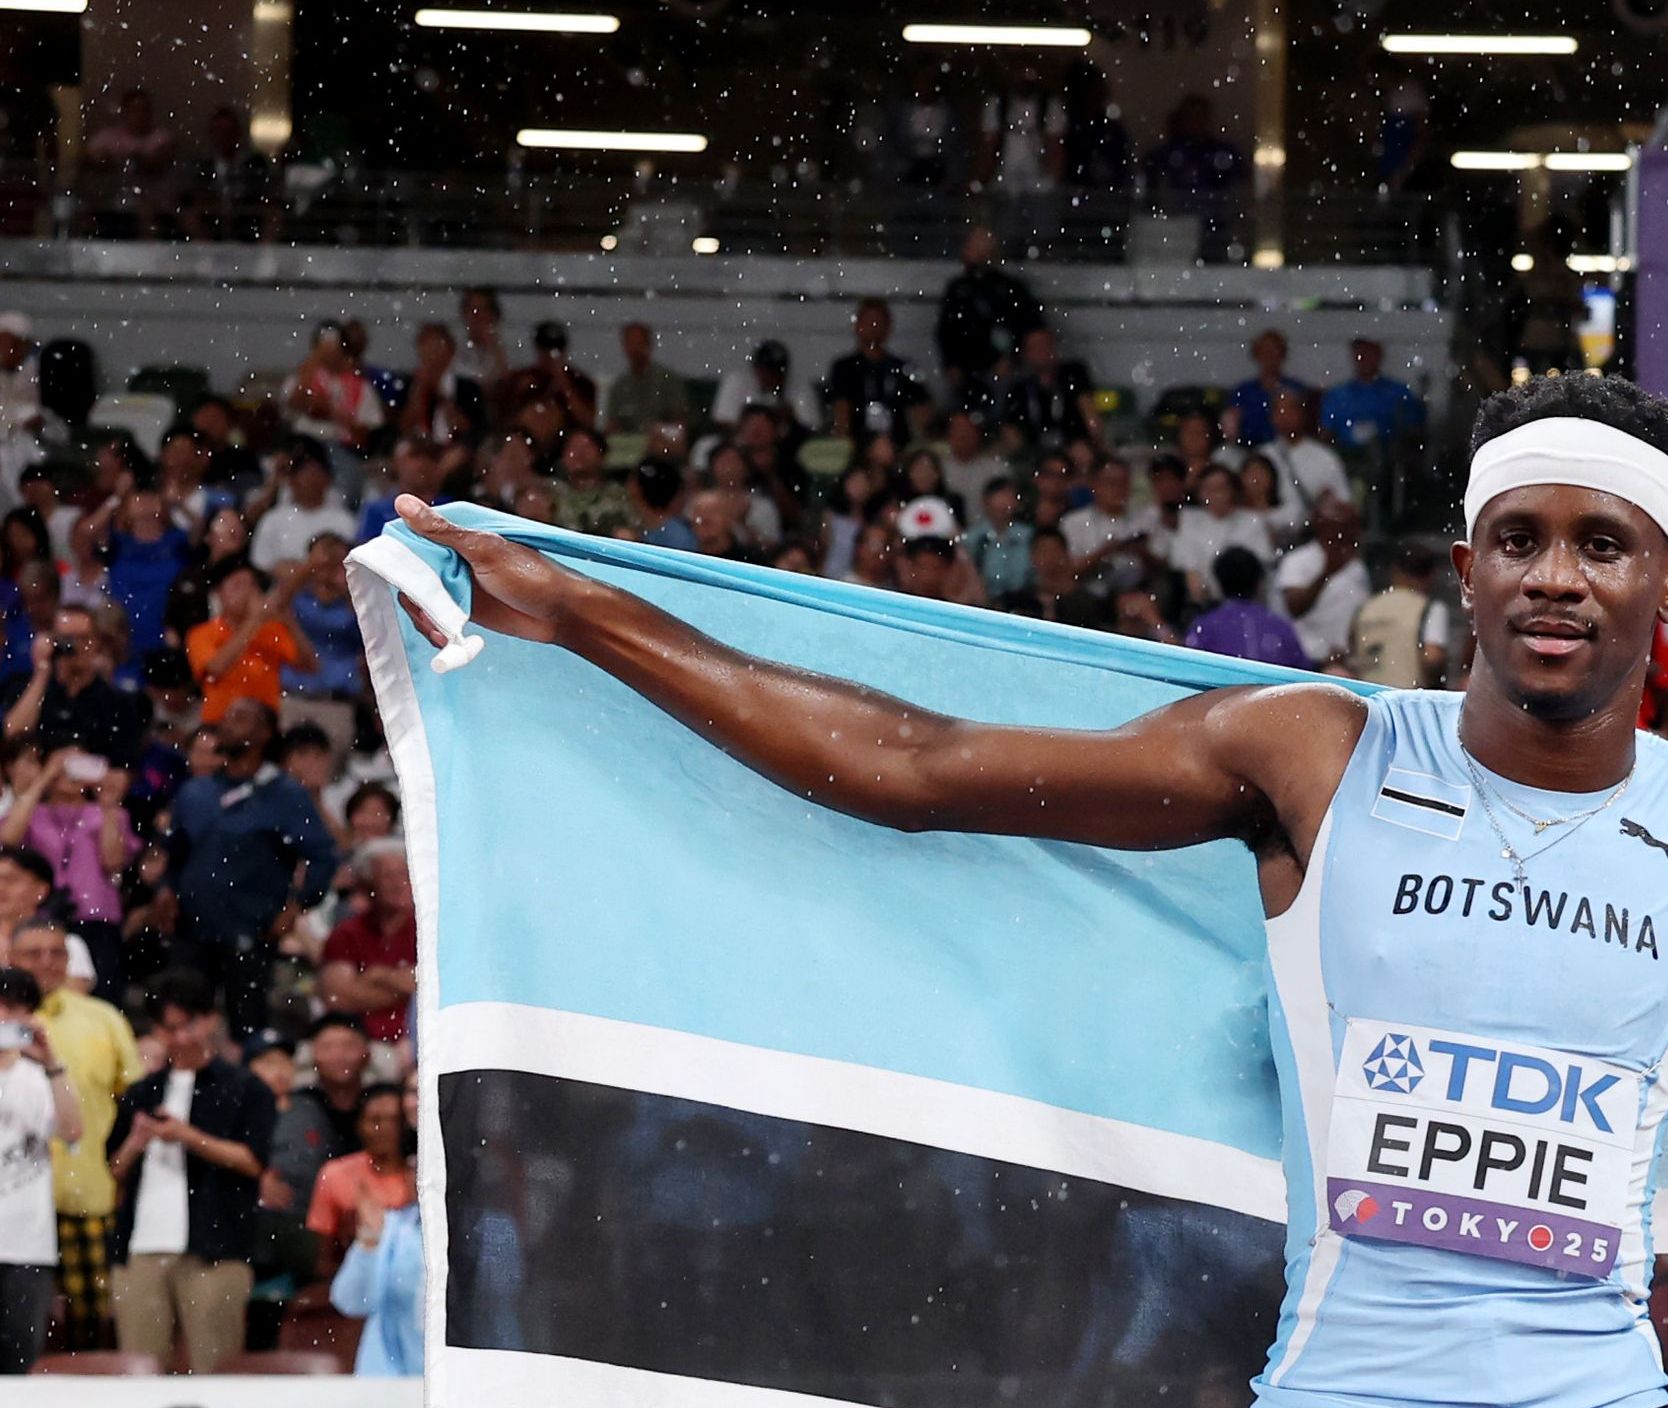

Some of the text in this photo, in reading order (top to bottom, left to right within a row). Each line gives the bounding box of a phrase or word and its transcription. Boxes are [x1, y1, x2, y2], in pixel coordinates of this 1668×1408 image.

[1393, 874, 1658, 960] BOTSWANA
[1429, 1040, 1622, 1134] TDK
[1366, 1113, 1594, 1210] EPPIE
